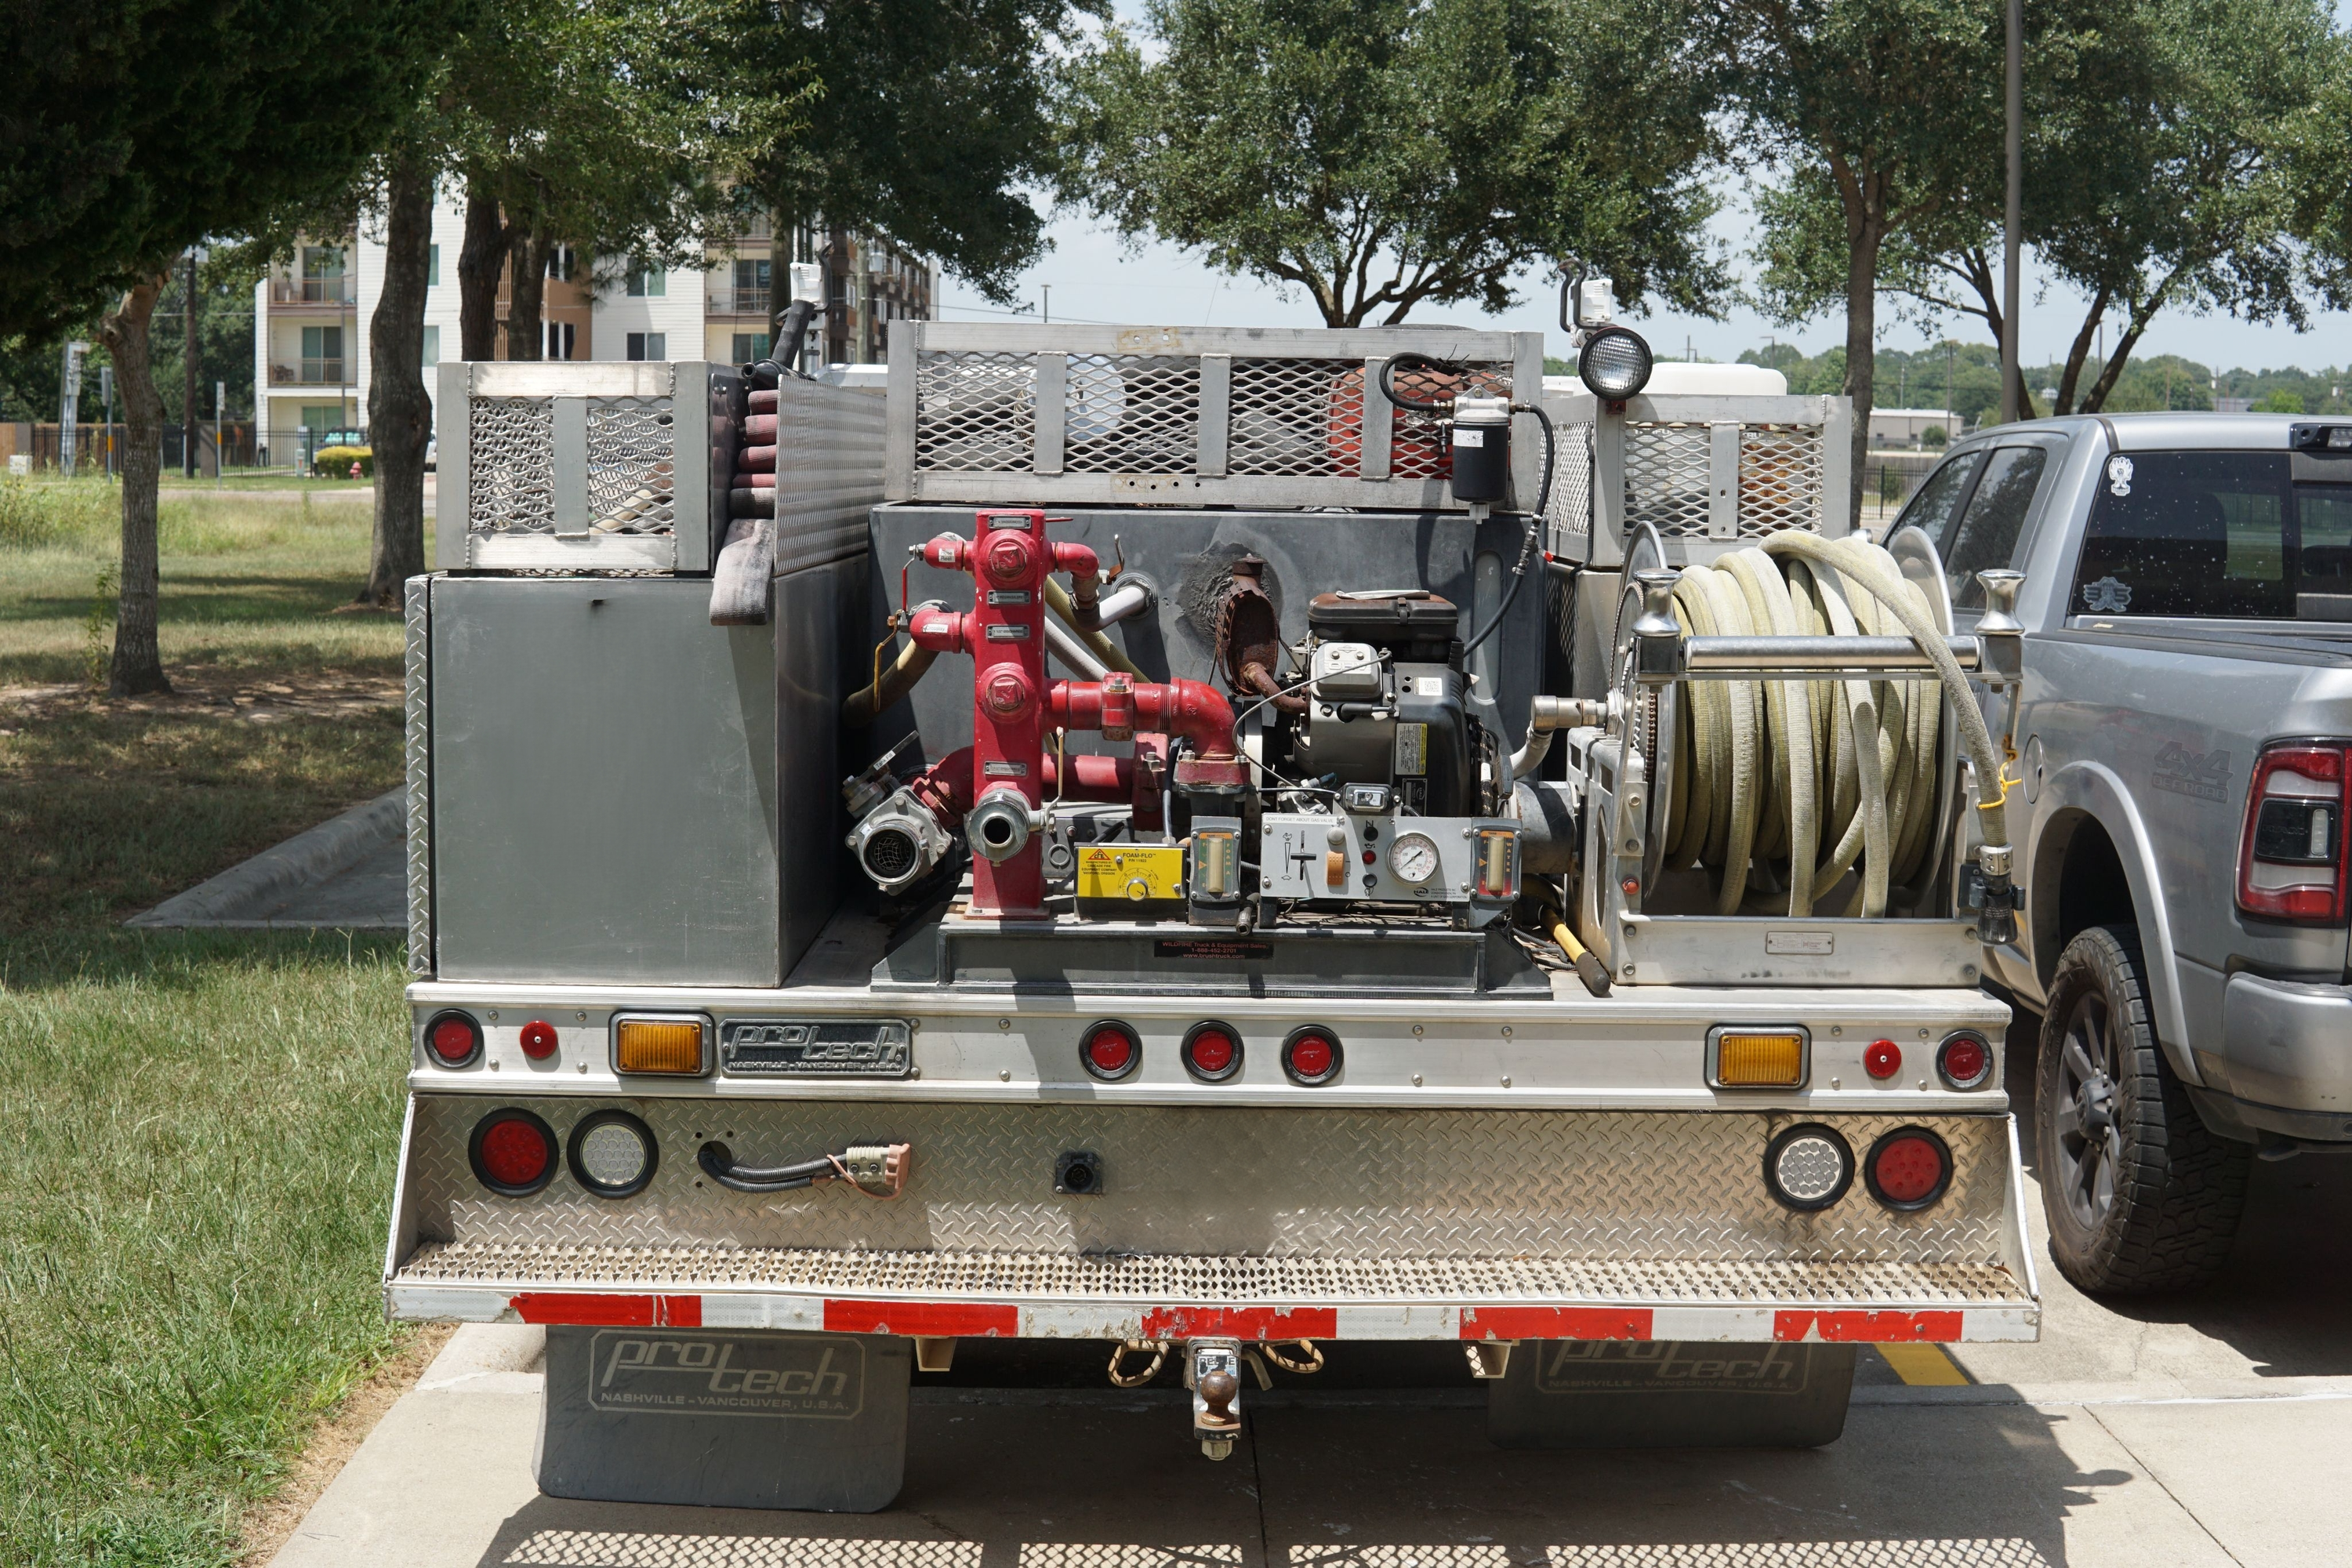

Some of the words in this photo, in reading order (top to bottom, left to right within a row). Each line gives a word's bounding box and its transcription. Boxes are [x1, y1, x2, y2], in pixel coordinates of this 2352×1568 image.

[875, 759, 887, 768] Tank
[2153, 775, 2181, 789] OFF
[2184, 782, 2227, 800] ROAD
[728, 1061, 788, 1071] NASHVILLE
[601, 1392, 685, 1406] NASHVILLE
[801, 1399, 850, 1410] U.S.A.
